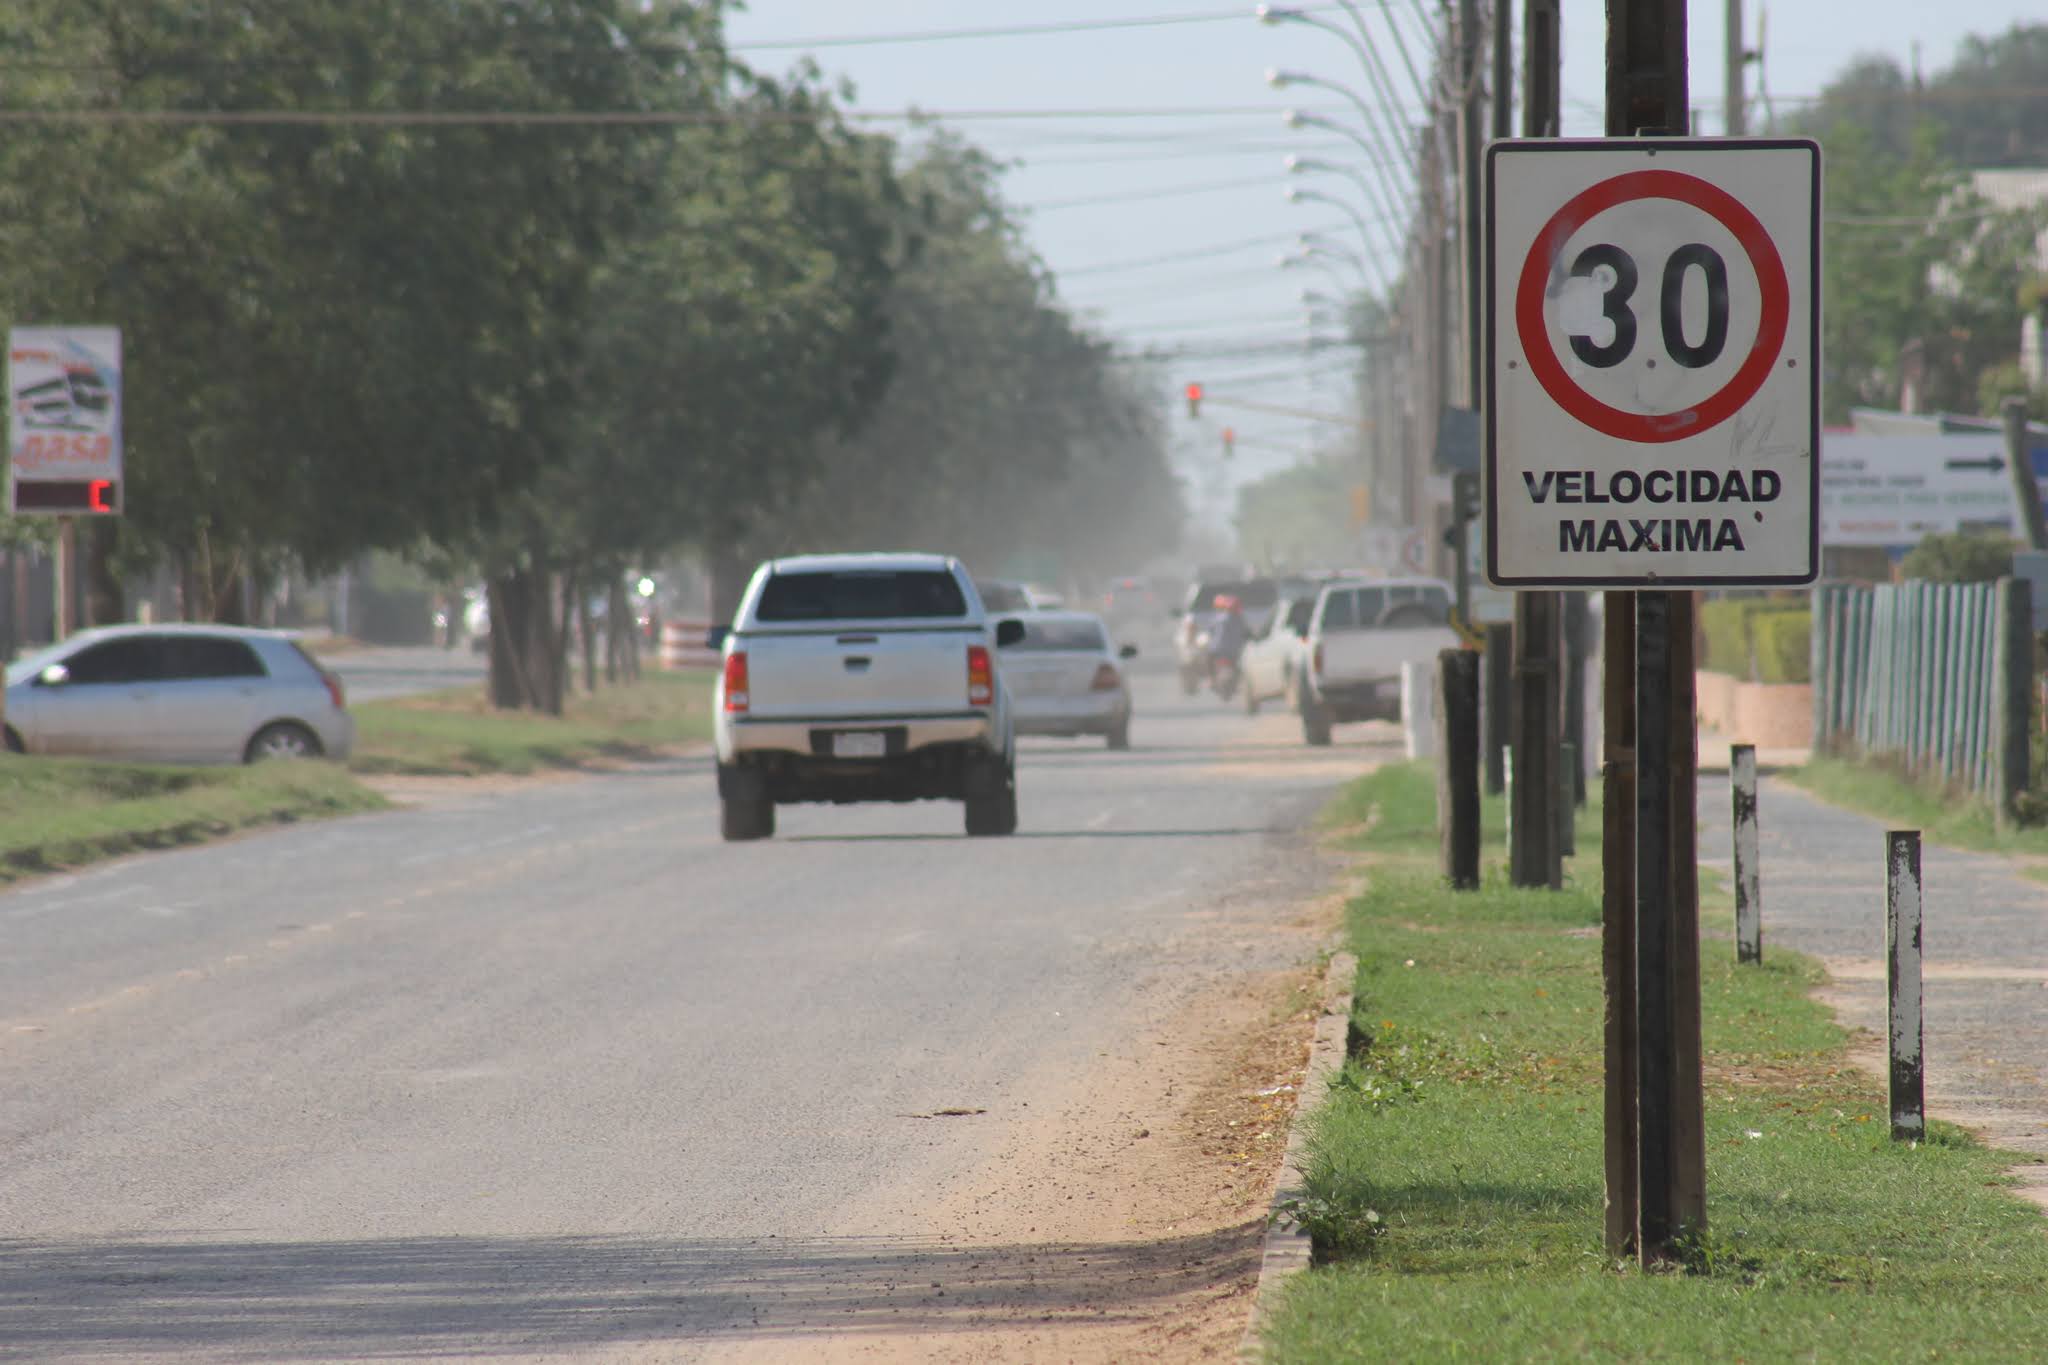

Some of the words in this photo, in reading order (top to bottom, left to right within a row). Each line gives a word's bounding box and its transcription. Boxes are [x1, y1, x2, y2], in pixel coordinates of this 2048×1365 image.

[1569, 243, 1729, 368] 30
[1522, 470, 1781, 503] VELOCIDAD
[1560, 519, 1745, 552] MAXIMA
